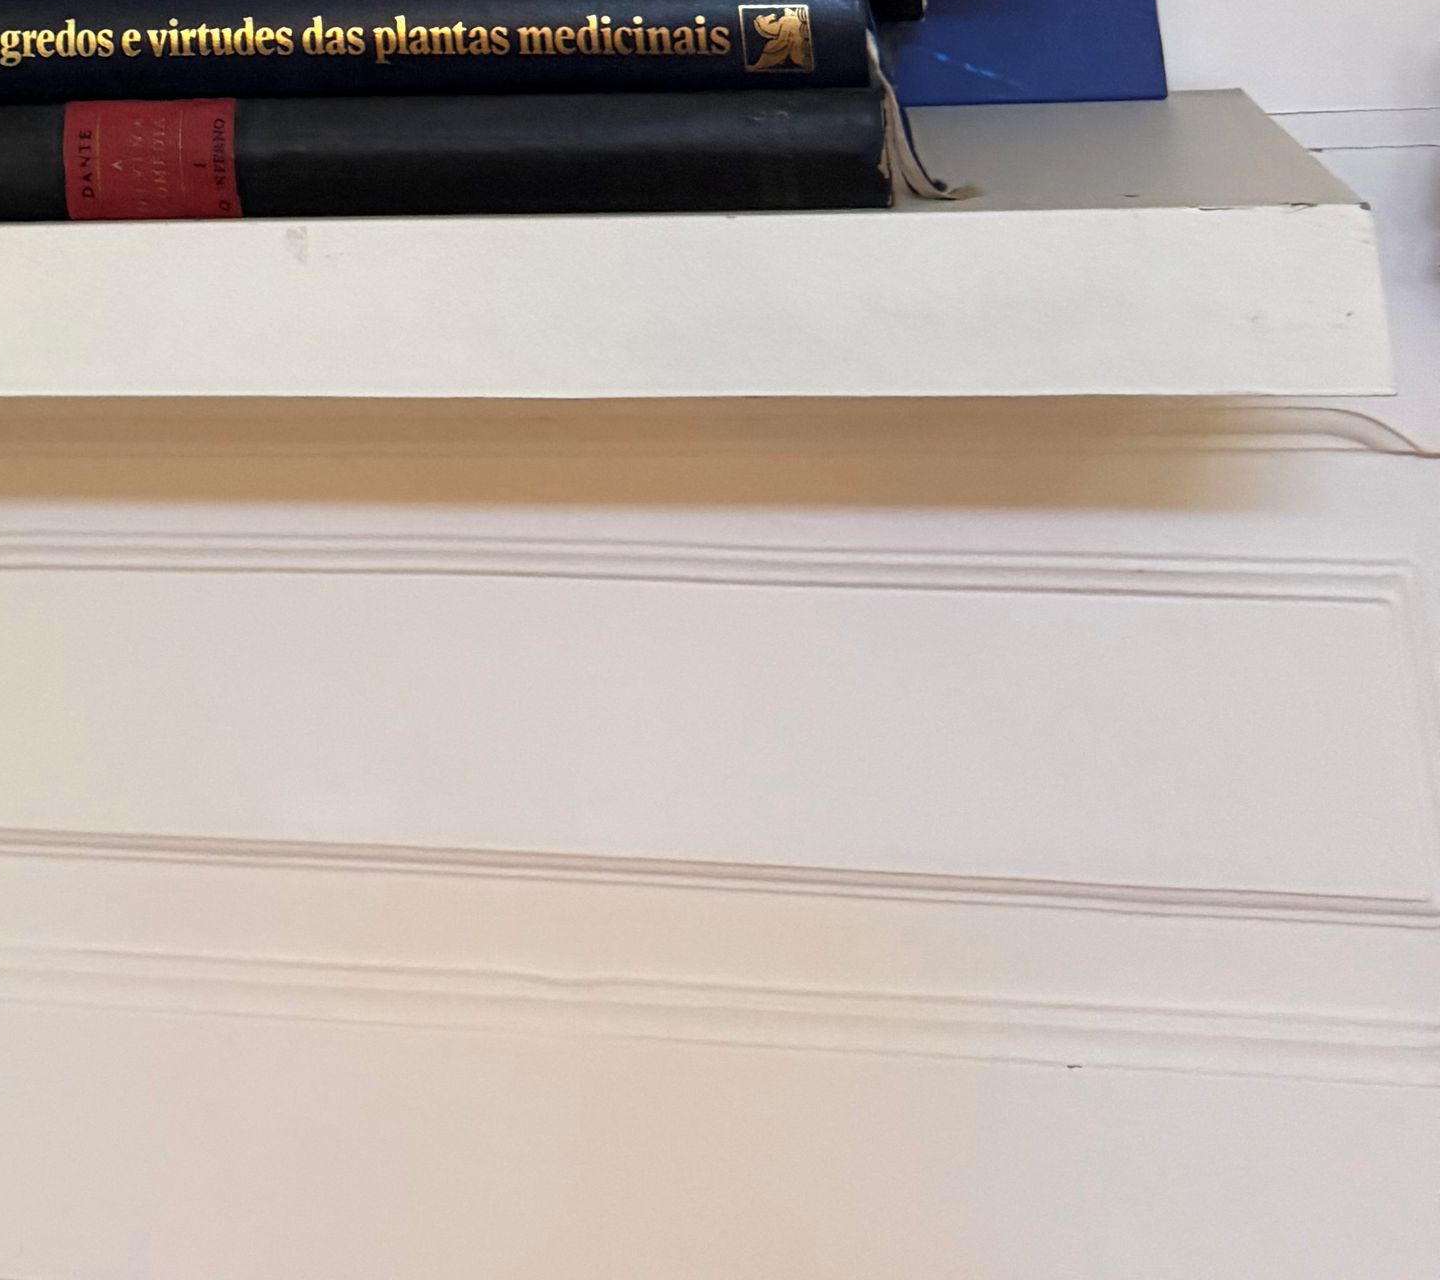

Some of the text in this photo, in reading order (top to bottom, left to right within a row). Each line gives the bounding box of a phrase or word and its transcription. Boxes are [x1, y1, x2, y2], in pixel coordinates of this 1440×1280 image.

[120, 29, 142, 58] e
[146, 16, 295, 58] virtudes
[301, 14, 364, 57] das
[372, 14, 512, 65] plantas
[516, 13, 732, 57] medicinais
[78, 130, 95, 199] DANTE
